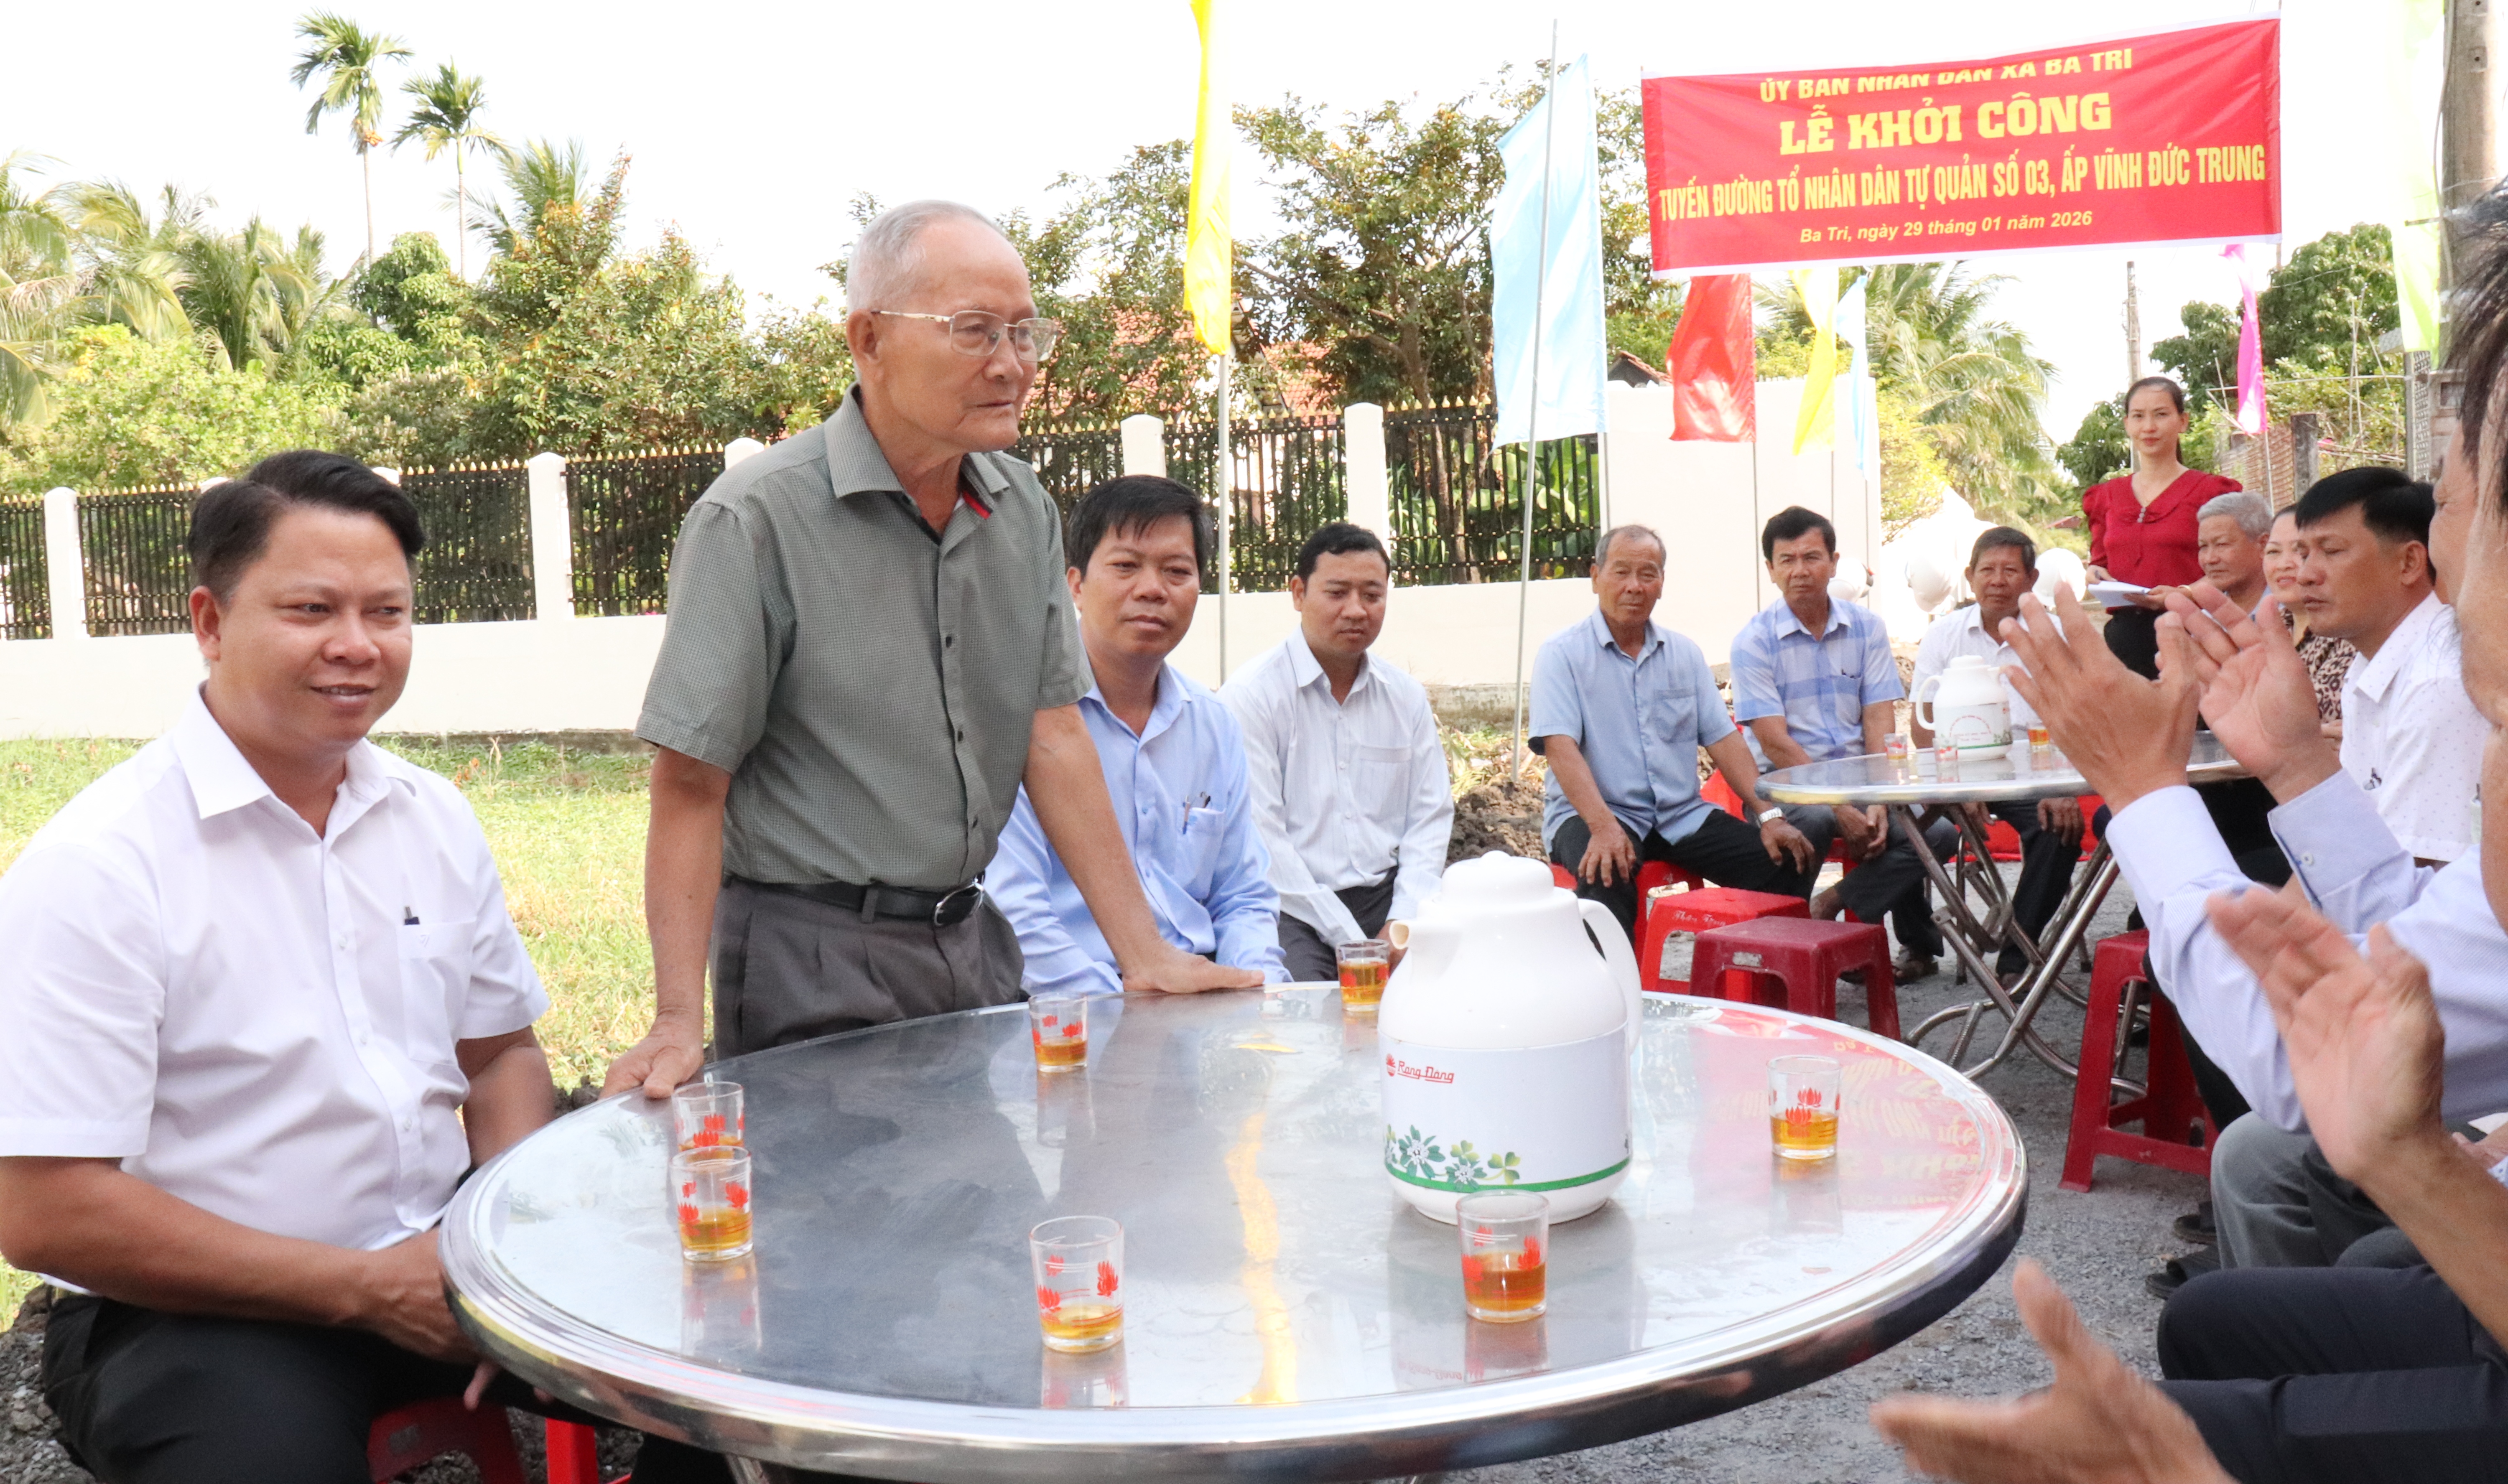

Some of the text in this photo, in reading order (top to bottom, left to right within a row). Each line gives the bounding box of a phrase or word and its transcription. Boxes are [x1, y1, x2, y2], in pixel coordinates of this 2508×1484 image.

[1760, 78, 1792, 102] ỦY
[1798, 78, 1850, 99] BAN
[2045, 56, 2082, 75] BA
[2089, 48, 2132, 71] TRI
[1779, 92, 2111, 155] LỄ KHỞI CÔNG
[1659, 142, 2265, 221] TUYẾN ĐƯỜNG TỔ NHÂN DÂN TỰ QUẢN SỐ 03, ẤP VĨNH ĐỨC TRUNG
[1800, 211, 2093, 243] Ba Tri, ngày 29 tháng 01 năm 2026
